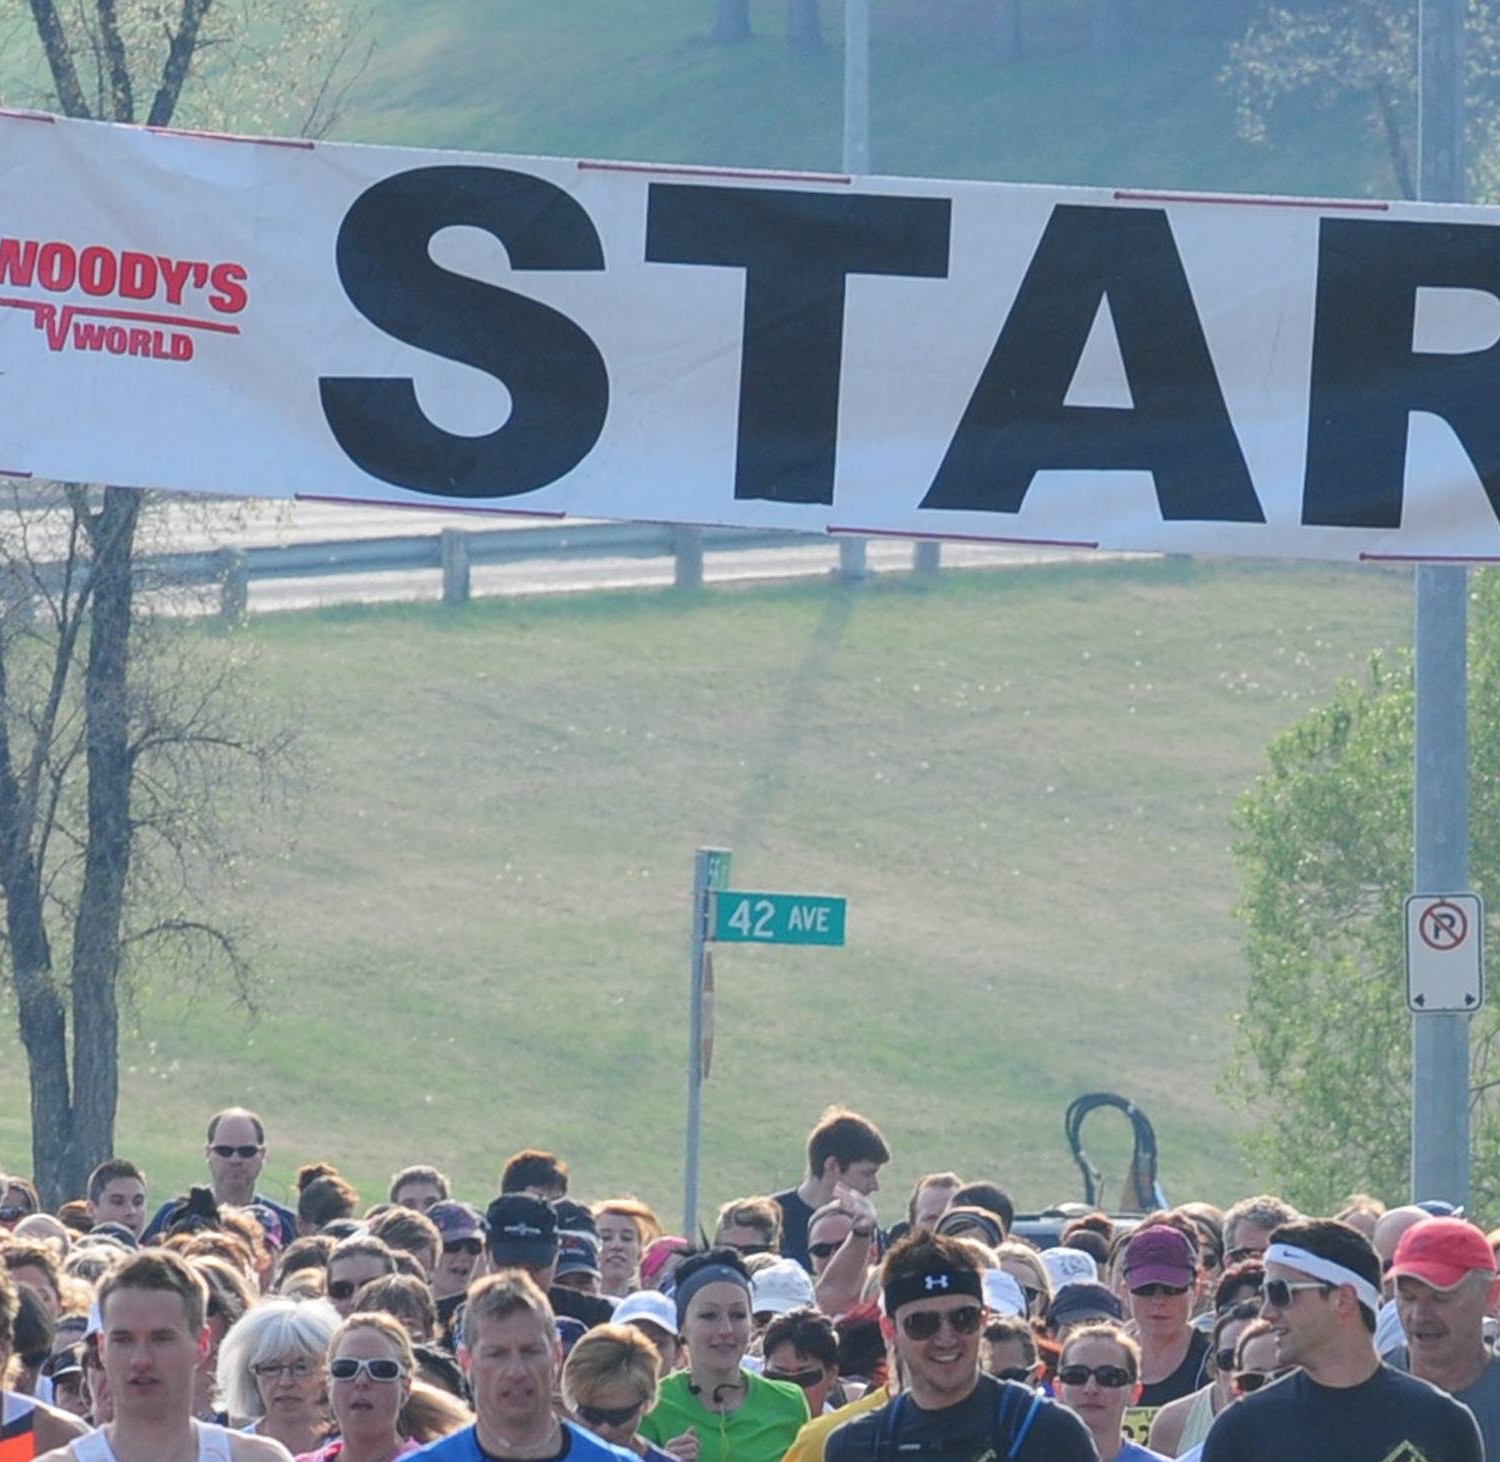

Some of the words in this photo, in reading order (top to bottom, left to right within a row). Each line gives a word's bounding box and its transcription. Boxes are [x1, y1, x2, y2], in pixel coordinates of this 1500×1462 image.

[73, 321, 194, 361] WORLD
[728, 900, 775, 937] 42
[788, 905, 831, 932] AVE
